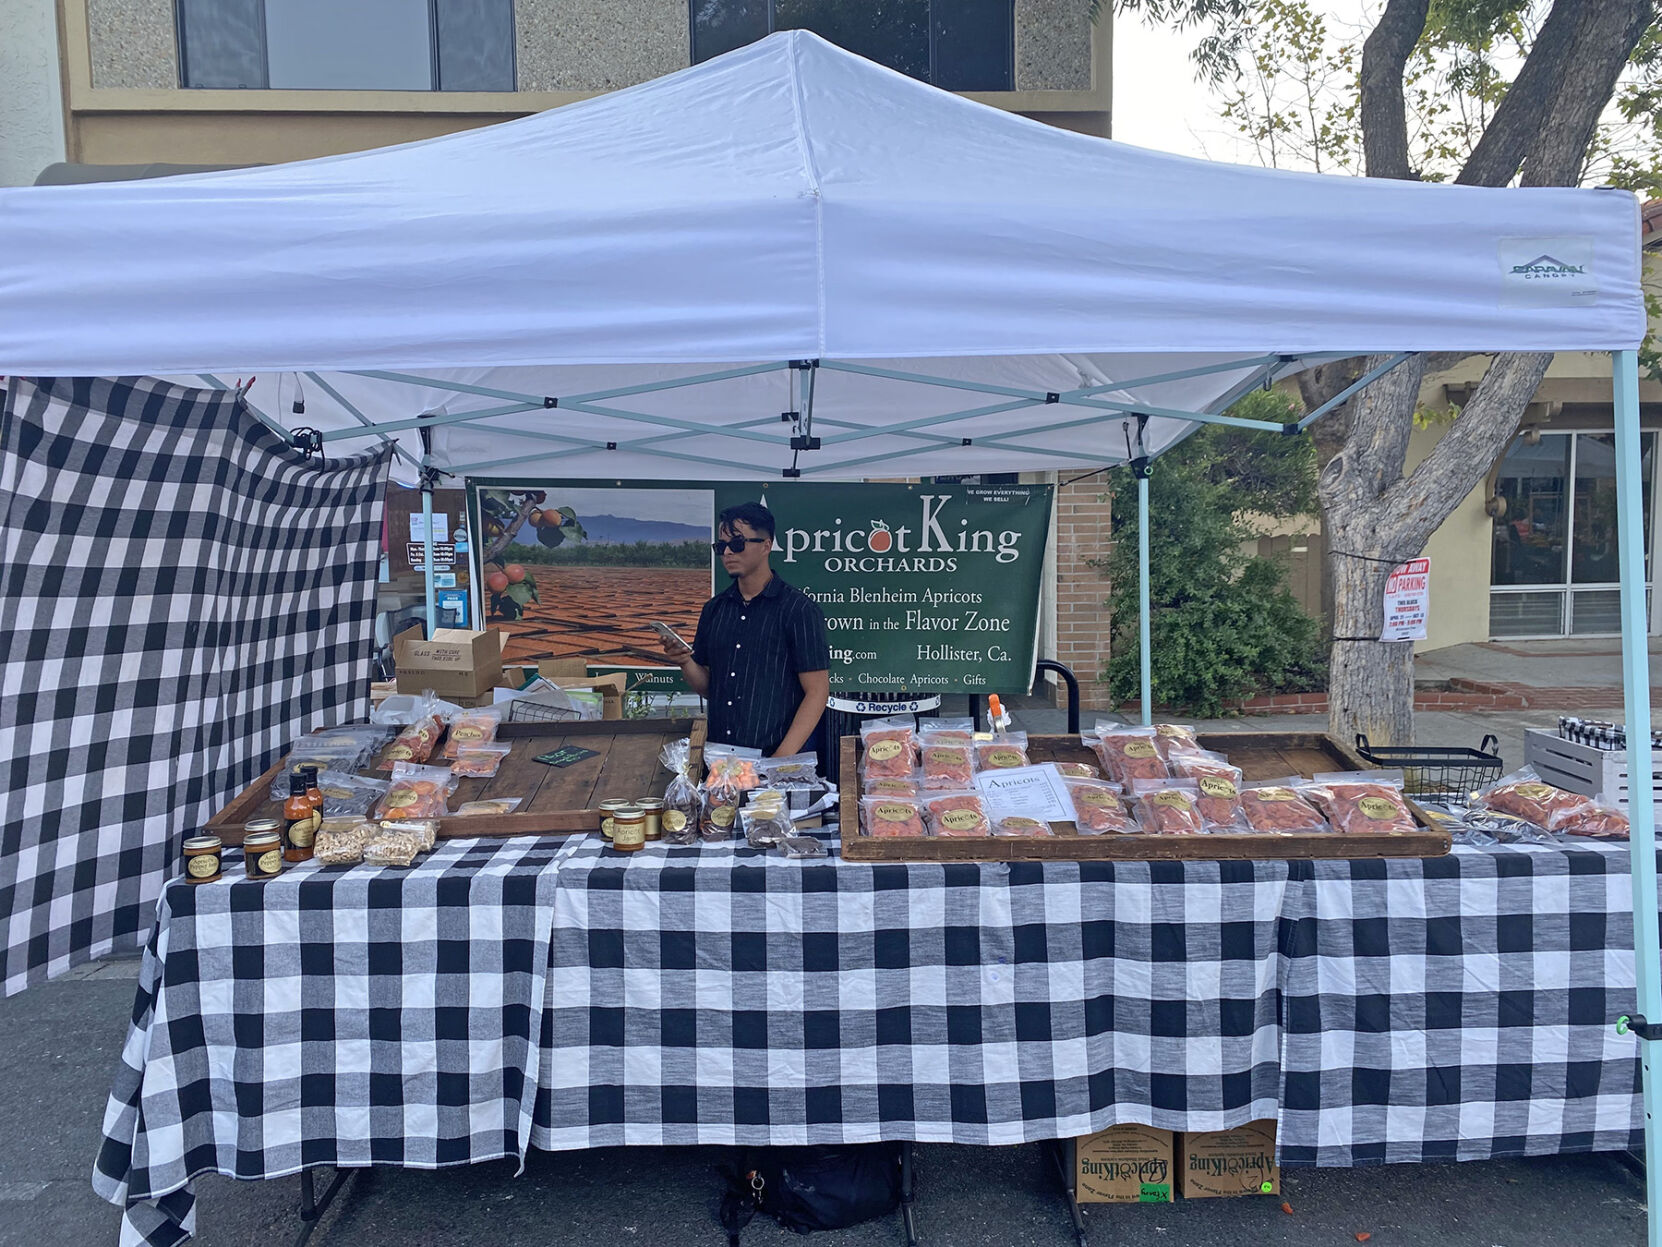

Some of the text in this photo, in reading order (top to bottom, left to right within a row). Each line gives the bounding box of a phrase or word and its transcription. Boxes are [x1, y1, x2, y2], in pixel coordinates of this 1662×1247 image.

[759, 494, 1022, 563] pricot King
[824, 557, 957, 572] ORCHARDS
[1399, 576, 1426, 592] PARKING
[802, 587, 982, 607] fornia Blenheim Apricots
[824, 610, 1010, 632] own in the Flavor Zone
[917, 645, 982, 662] Hollister,
[987, 647, 1012, 662] Ca.
[858, 673, 905, 684] Chocolate
[910, 674, 949, 687] Apricots
[963, 674, 987, 685] Gifts
[868, 702, 907, 713] Recycle
[988, 776, 1041, 789] Apricots
